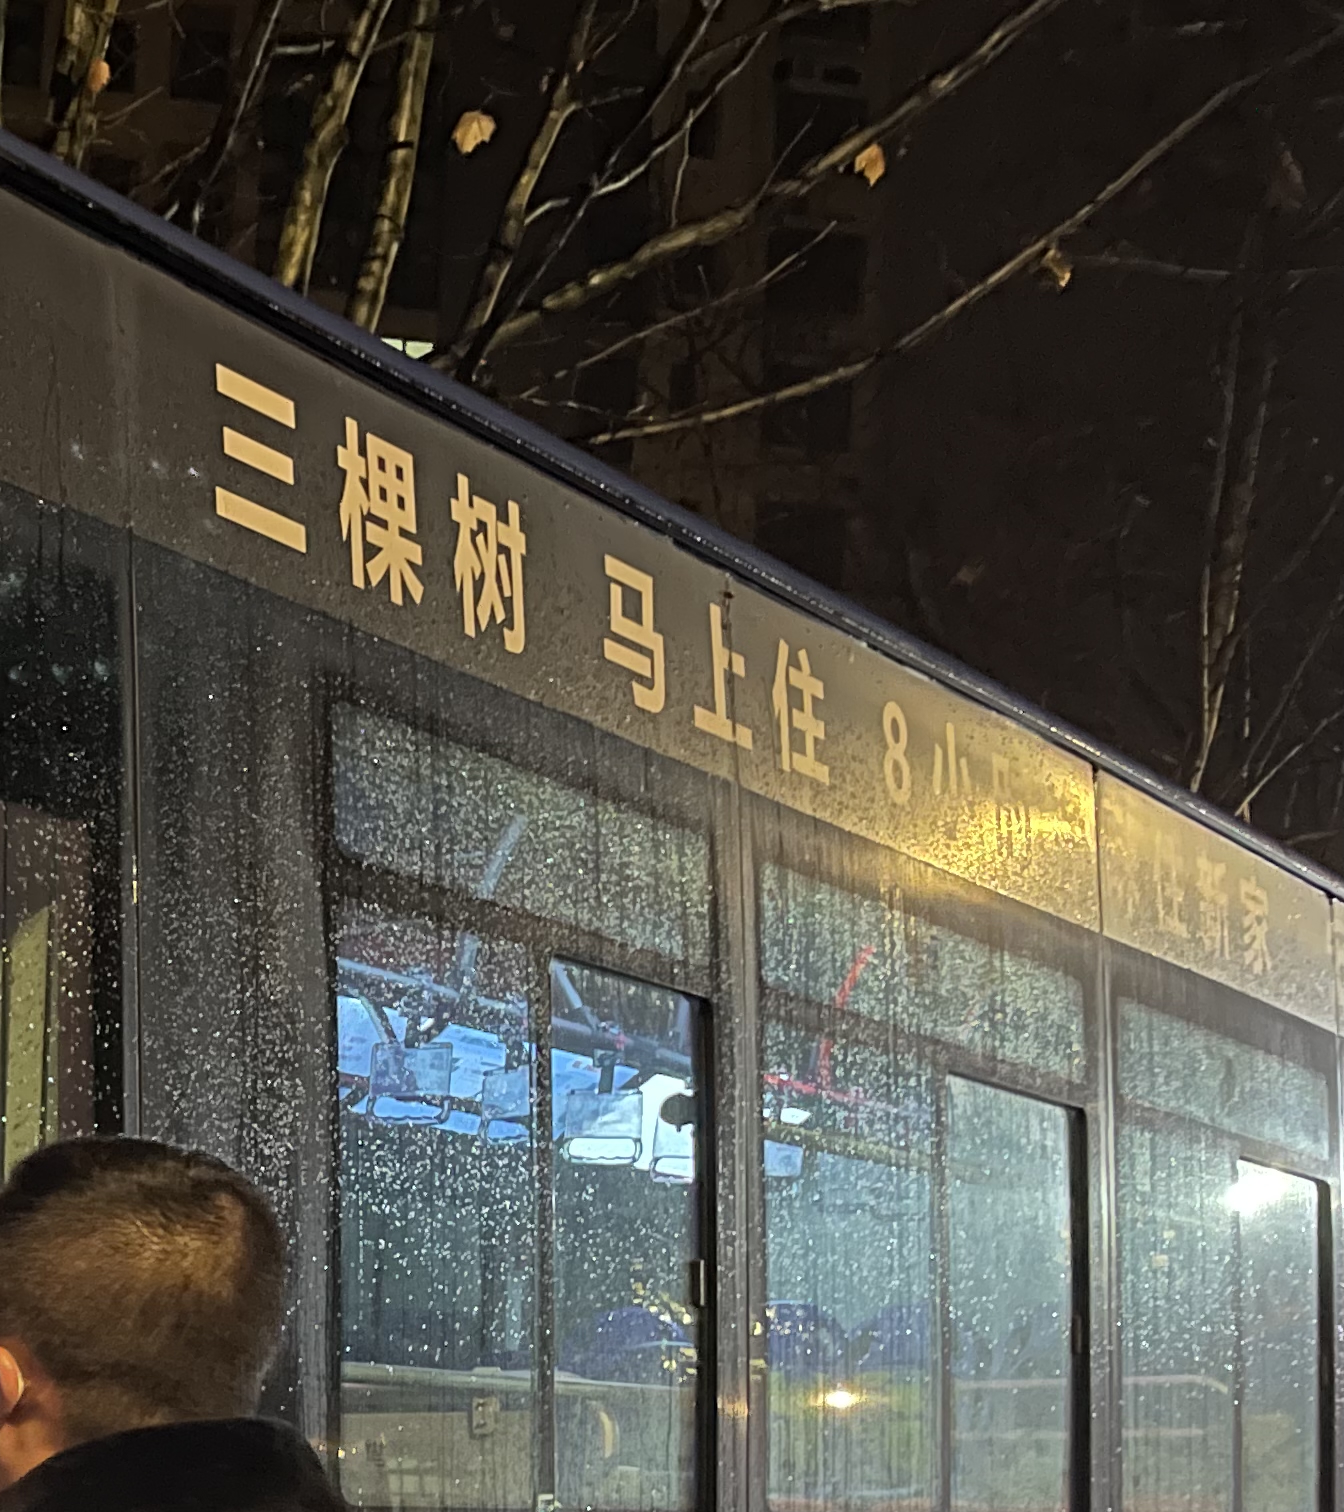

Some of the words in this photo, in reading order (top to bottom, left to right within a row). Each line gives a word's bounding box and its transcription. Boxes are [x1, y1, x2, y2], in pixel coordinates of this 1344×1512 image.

[215, 362, 527, 655] 三棵树
[603, 553, 831, 786] 马上住
